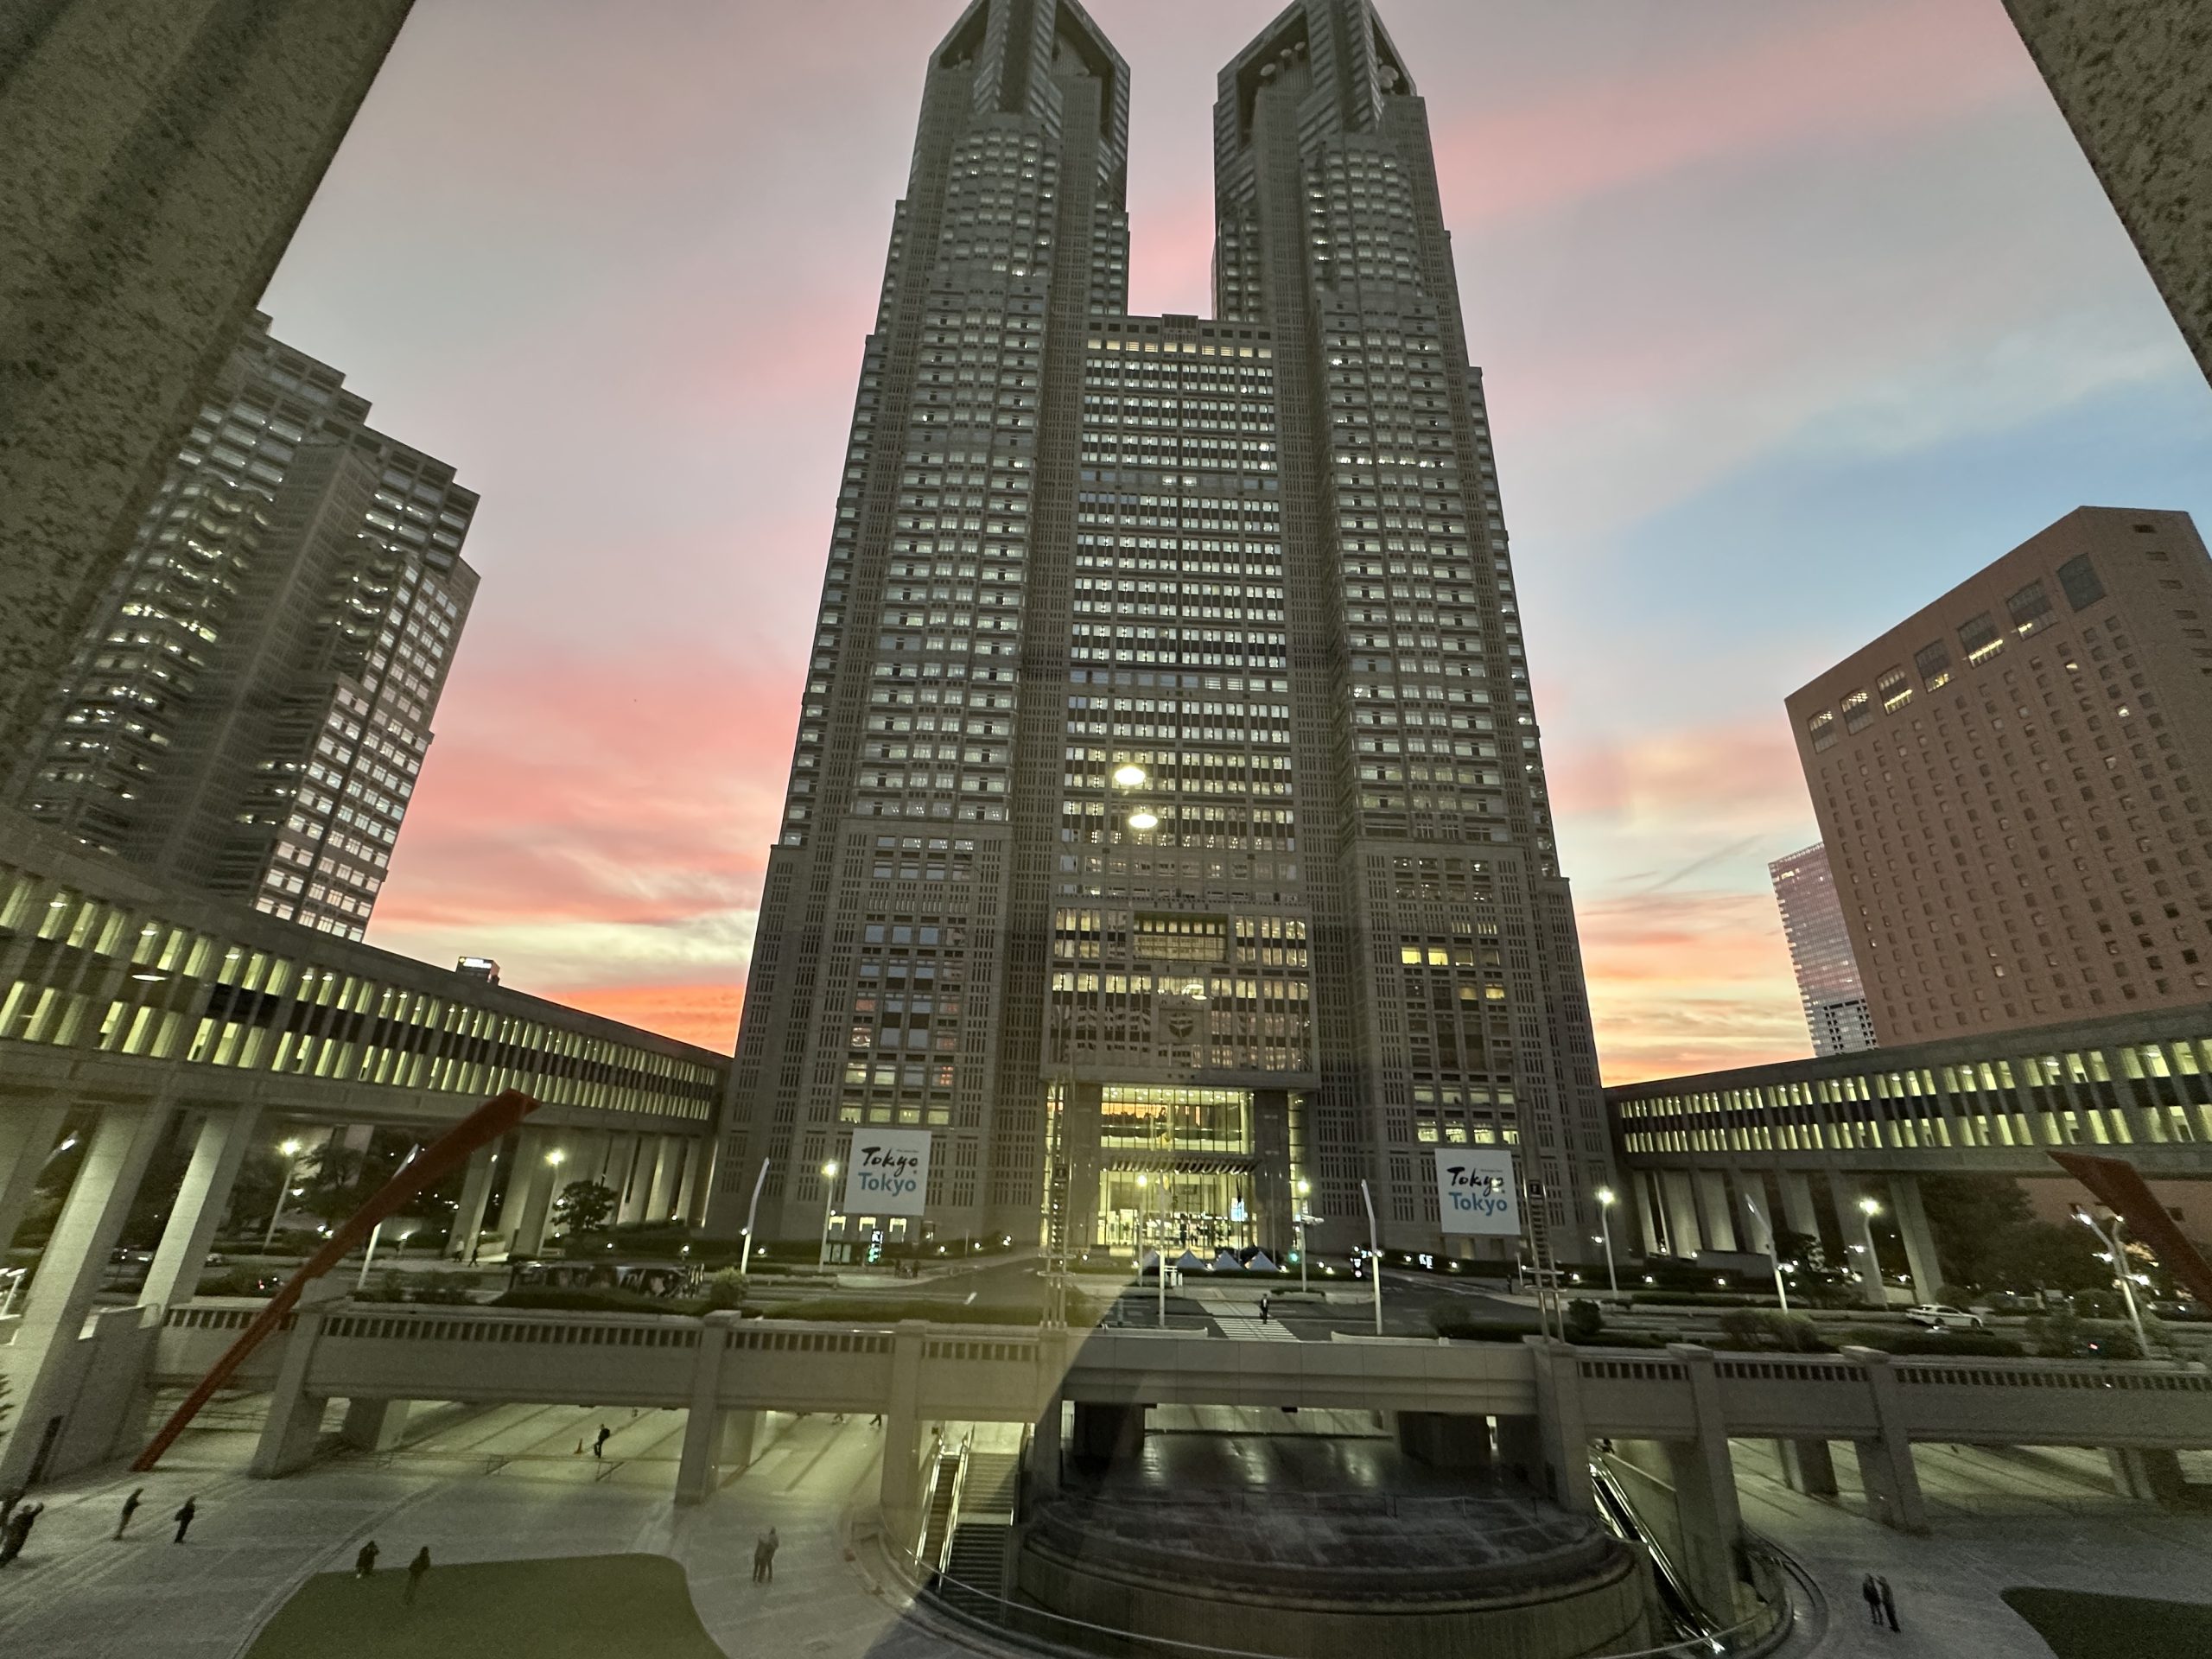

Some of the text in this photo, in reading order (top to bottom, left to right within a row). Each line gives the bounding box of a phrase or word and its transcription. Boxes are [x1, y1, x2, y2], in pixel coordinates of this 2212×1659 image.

[861, 1147, 918, 1177] Tokyo
[858, 1173, 917, 1197] Tokyo
[1448, 1192, 1507, 1216] Tokyo
